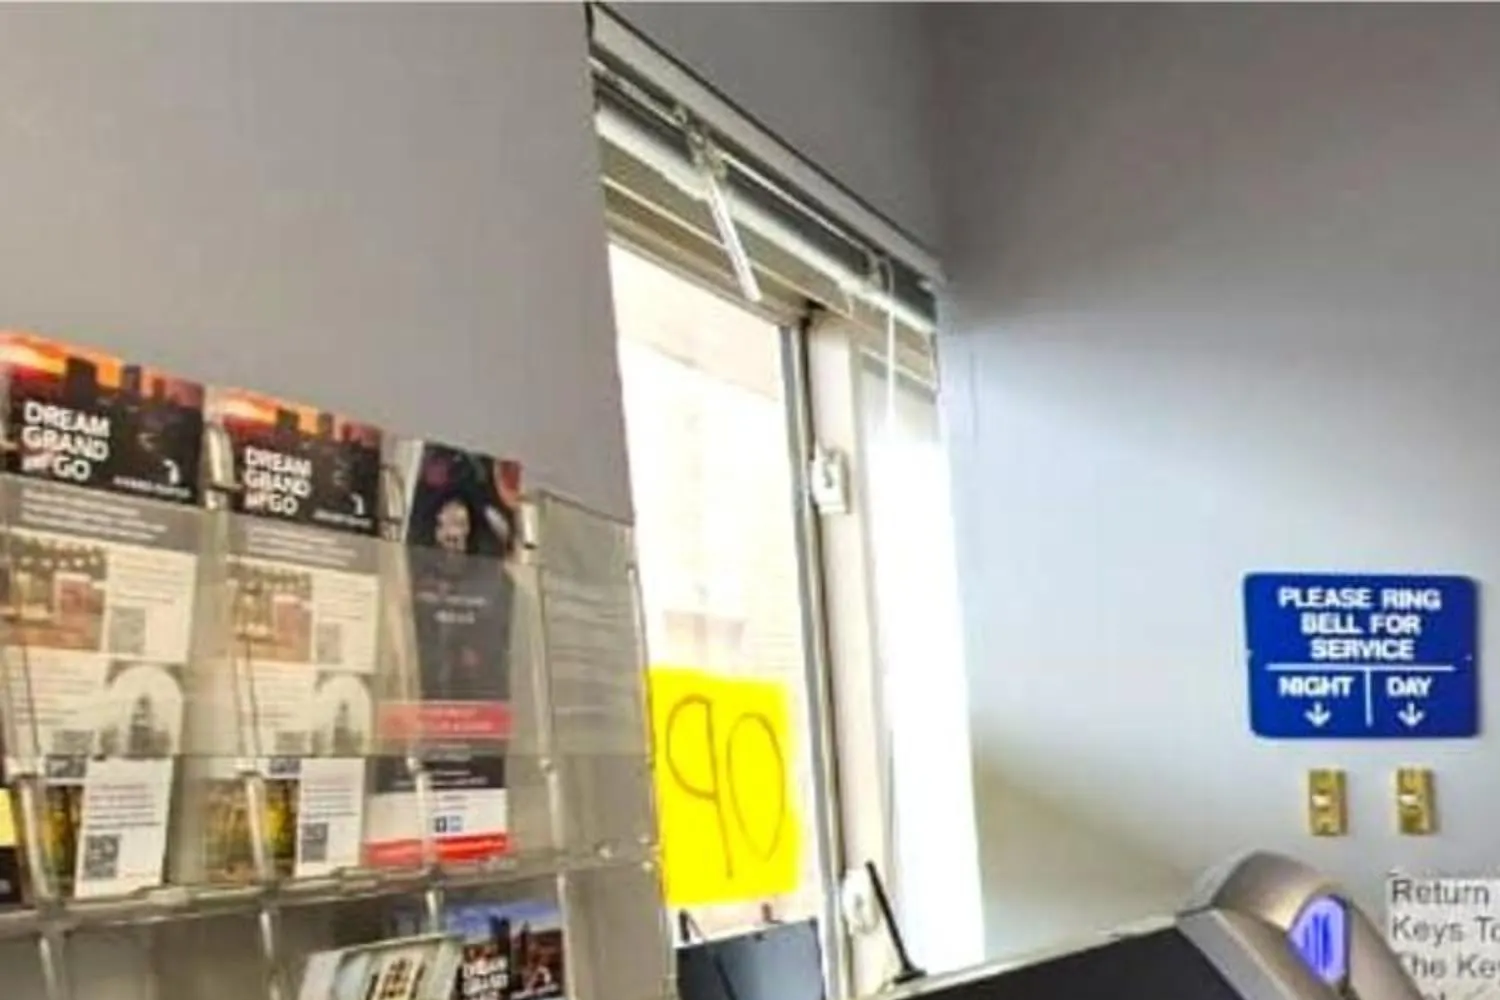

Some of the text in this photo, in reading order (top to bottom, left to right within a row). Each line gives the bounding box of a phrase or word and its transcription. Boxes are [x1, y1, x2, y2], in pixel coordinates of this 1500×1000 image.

[24, 400, 110, 437] DREAM
[22, 426, 109, 461] GRAND
[1279, 587, 1441, 610] PLEASE RING
[1302, 612, 1421, 635] BELL FOR
[1311, 638, 1414, 661] SERVICE
[1279, 676, 1432, 698] NIGHT DAY
[1391, 879, 1490, 905] Return
[1391, 915, 1464, 948] Keys
[1402, 952, 1447, 978] he
